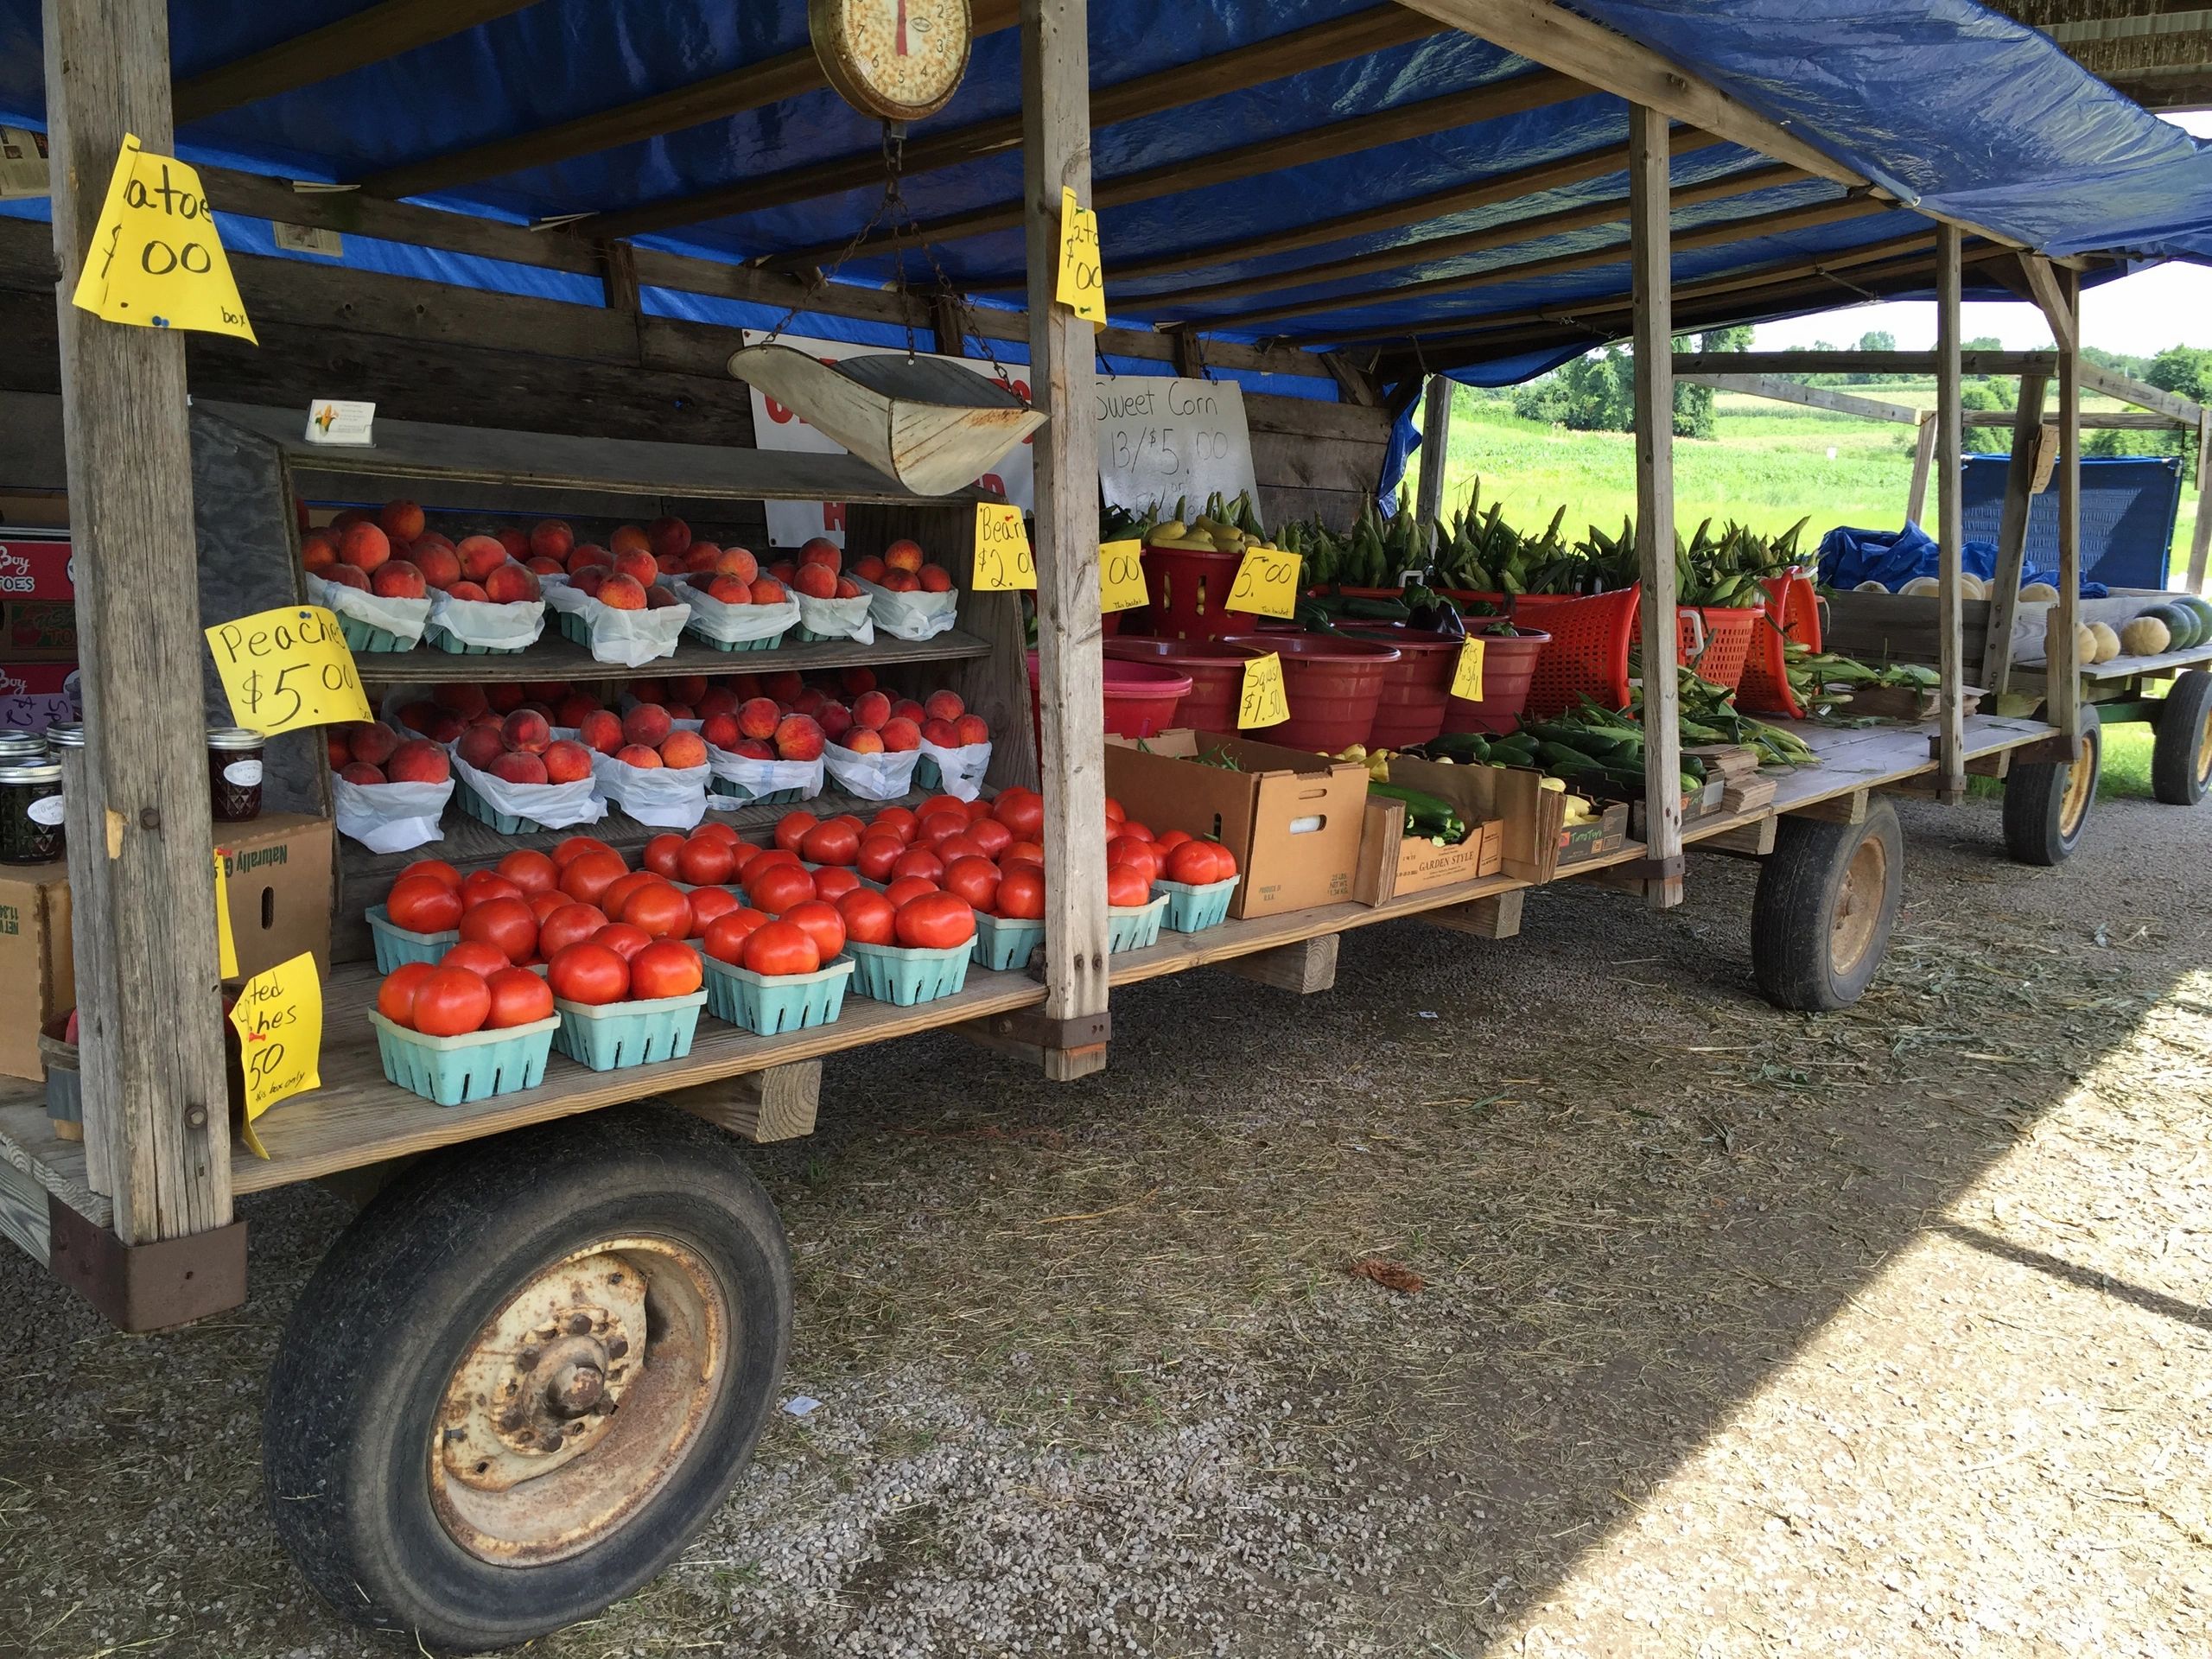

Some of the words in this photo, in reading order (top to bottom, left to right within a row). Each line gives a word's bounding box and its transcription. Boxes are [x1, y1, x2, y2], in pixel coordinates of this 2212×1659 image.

[937, 4, 944, 19] 2
[857, 25, 865, 38] 7
[937, 39, 944, 54] 3
[871, 54, 880, 68] 6
[898, 69, 906, 84] 5
[920, 64, 928, 78] 4
[220, 307, 246, 325] box
[1096, 381, 1155, 421] Sweet
[1168, 381, 1218, 416] Corn
[236, 844, 288, 874] Naturally
[1419, 856, 1449, 872] GARDEN
[1451, 850, 1474, 864] STYLE
